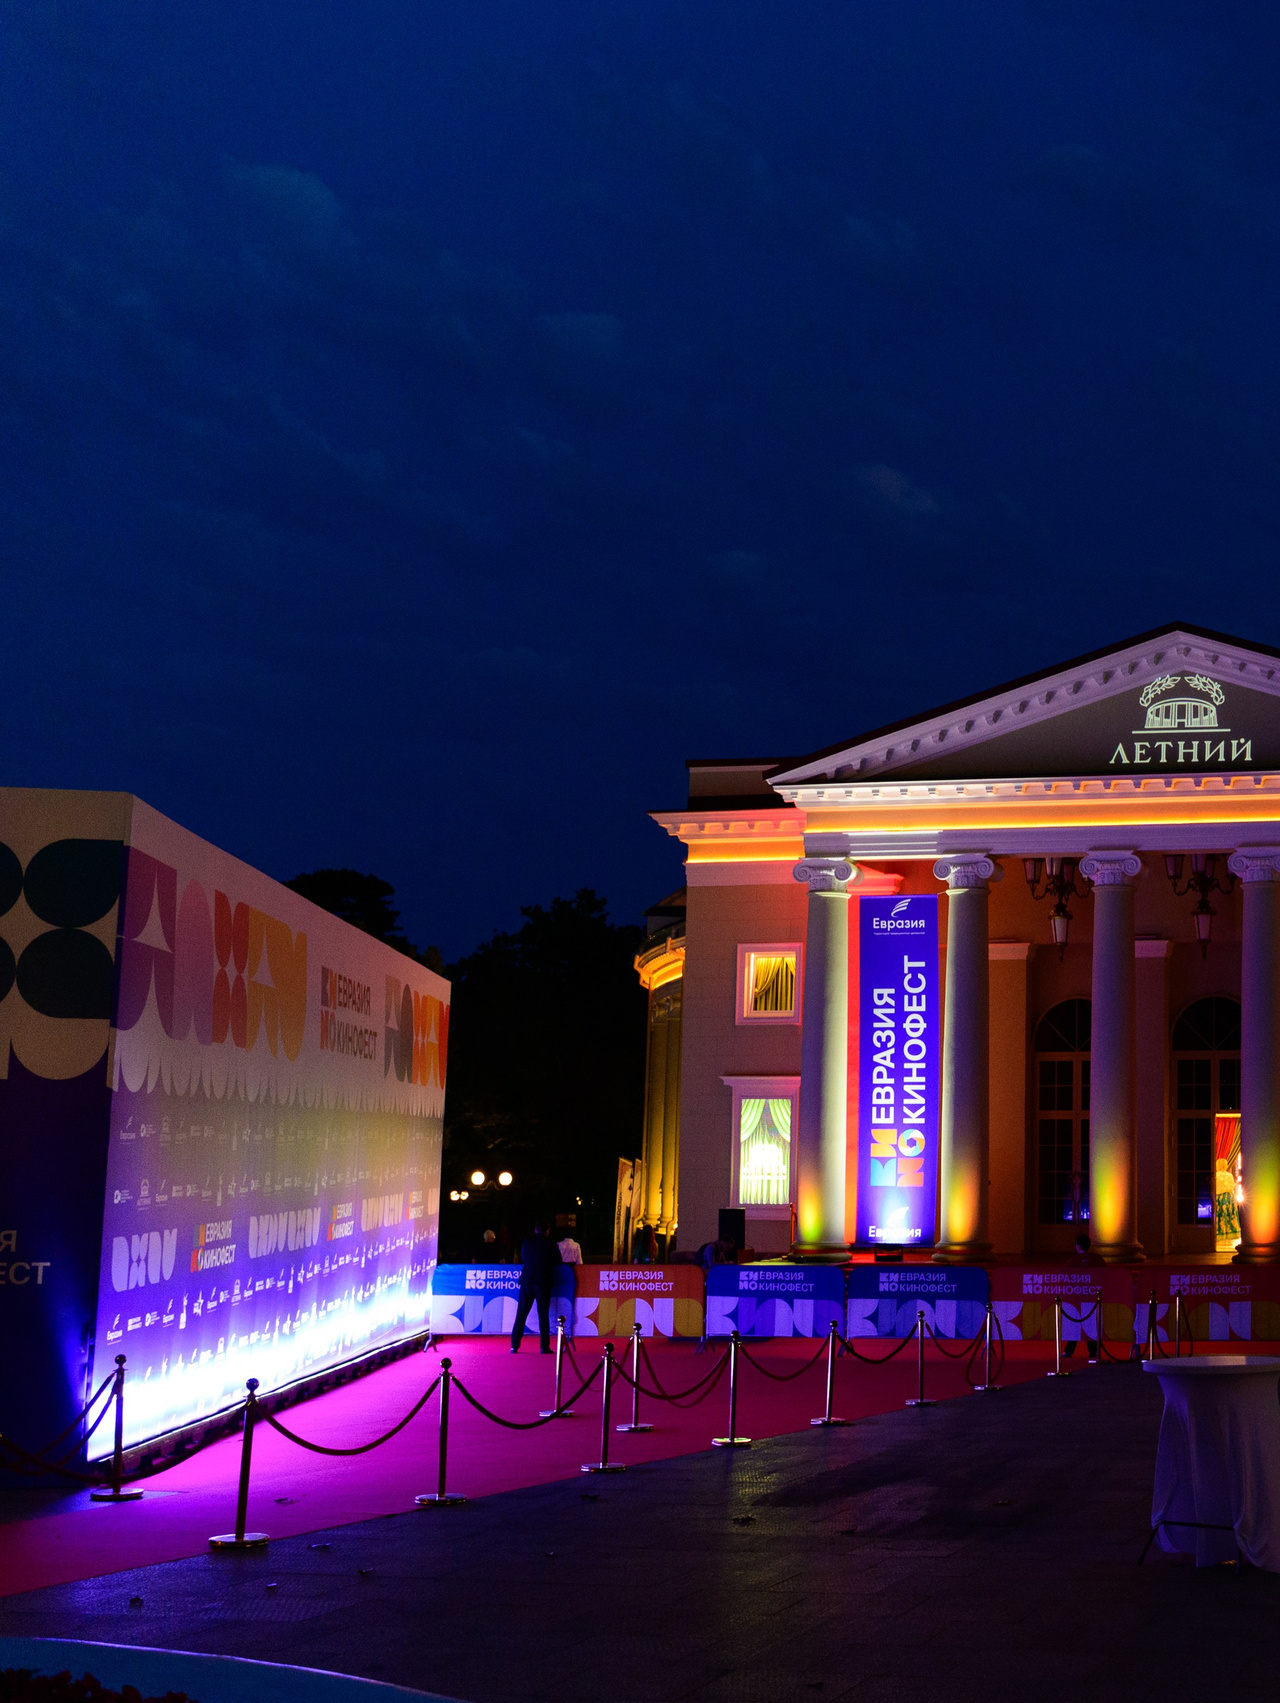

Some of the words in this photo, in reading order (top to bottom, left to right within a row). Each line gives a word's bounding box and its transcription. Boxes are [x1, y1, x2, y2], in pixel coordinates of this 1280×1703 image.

[1110, 738, 1252, 764] ЛЕТНИЙ
[873, 918, 925, 932] Евразия
[338, 974, 371, 1016] ЕВРАЗИЯ
[336, 1020, 378, 1060] КИНОФЕСТ
[903, 955, 927, 1124] КИНОФЕСТ
[872, 988, 896, 1124] ЕВРАЗИЯ
[206, 1220, 232, 1242] ЕВРАЗИЯ
[203, 1244, 236, 1270] КИНОФЕСТ
[620, 1271, 664, 1280] ЕВРАЗИЯ
[760, 1272, 804, 1280] ЕВРАЗИЯ
[900, 1272, 946, 1282] ЕВРАЗИЯ
[1044, 1274, 1091, 1284] ЕВРАЗИЯ
[1192, 1274, 1240, 1284] ЕВРАЗИЯ
[620, 1282, 674, 1291] КИНОФЕСТ
[759, 1282, 814, 1292] КИНОФЕСТ
[900, 1284, 957, 1293] КИНОФЕСТ
[1191, 1286, 1251, 1295] КИНОФЕСТ
